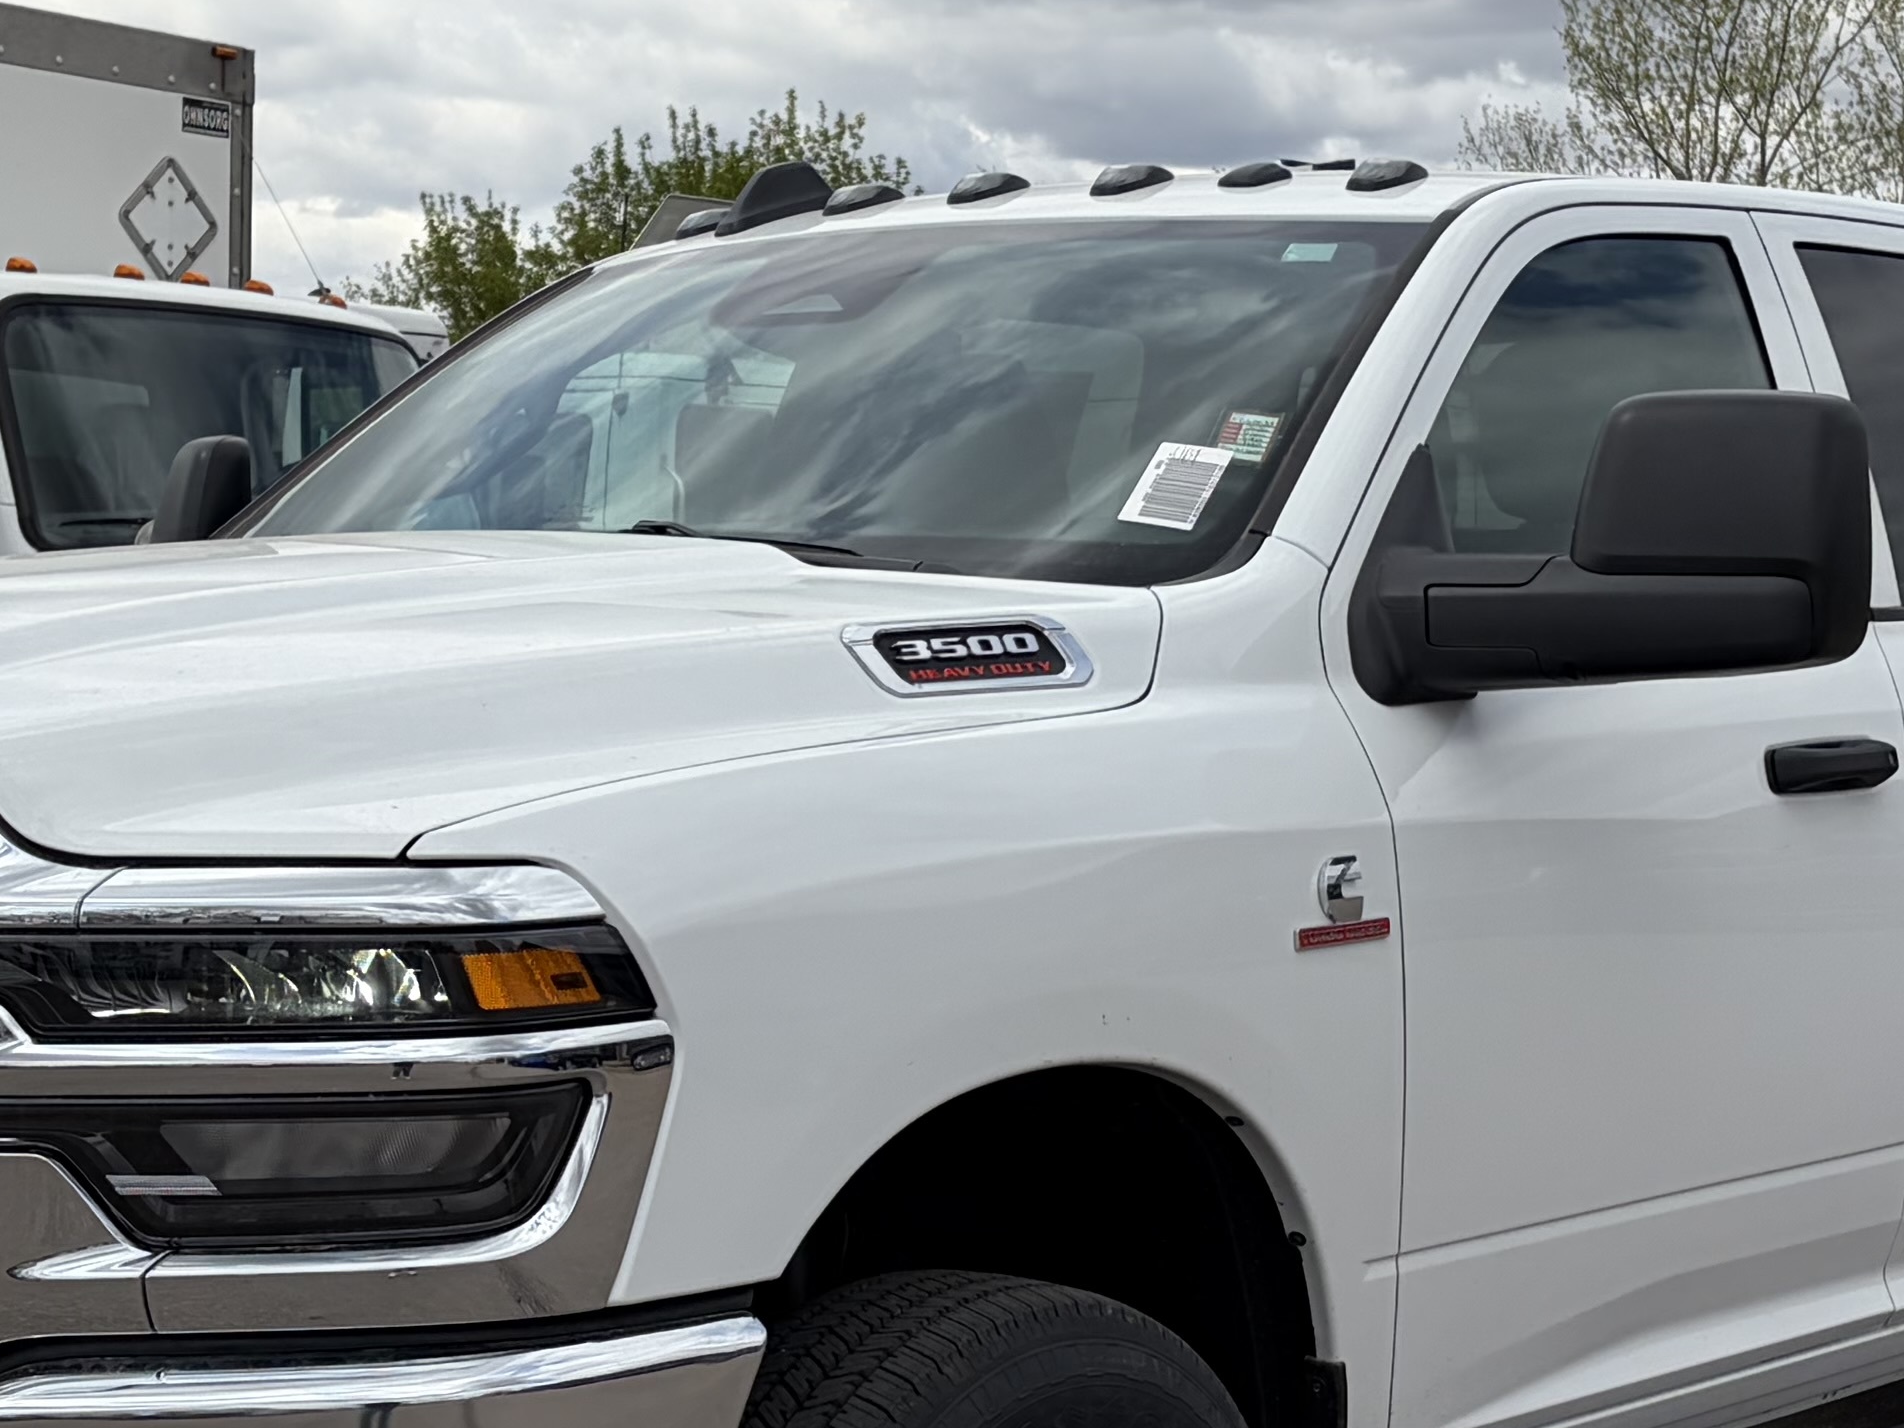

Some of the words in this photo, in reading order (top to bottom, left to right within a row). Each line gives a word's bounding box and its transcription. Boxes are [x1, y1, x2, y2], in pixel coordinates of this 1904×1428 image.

[891, 632, 1040, 661] 3500
[908, 665, 986, 681] HEAVY
[989, 661, 1052, 676] DUTY
